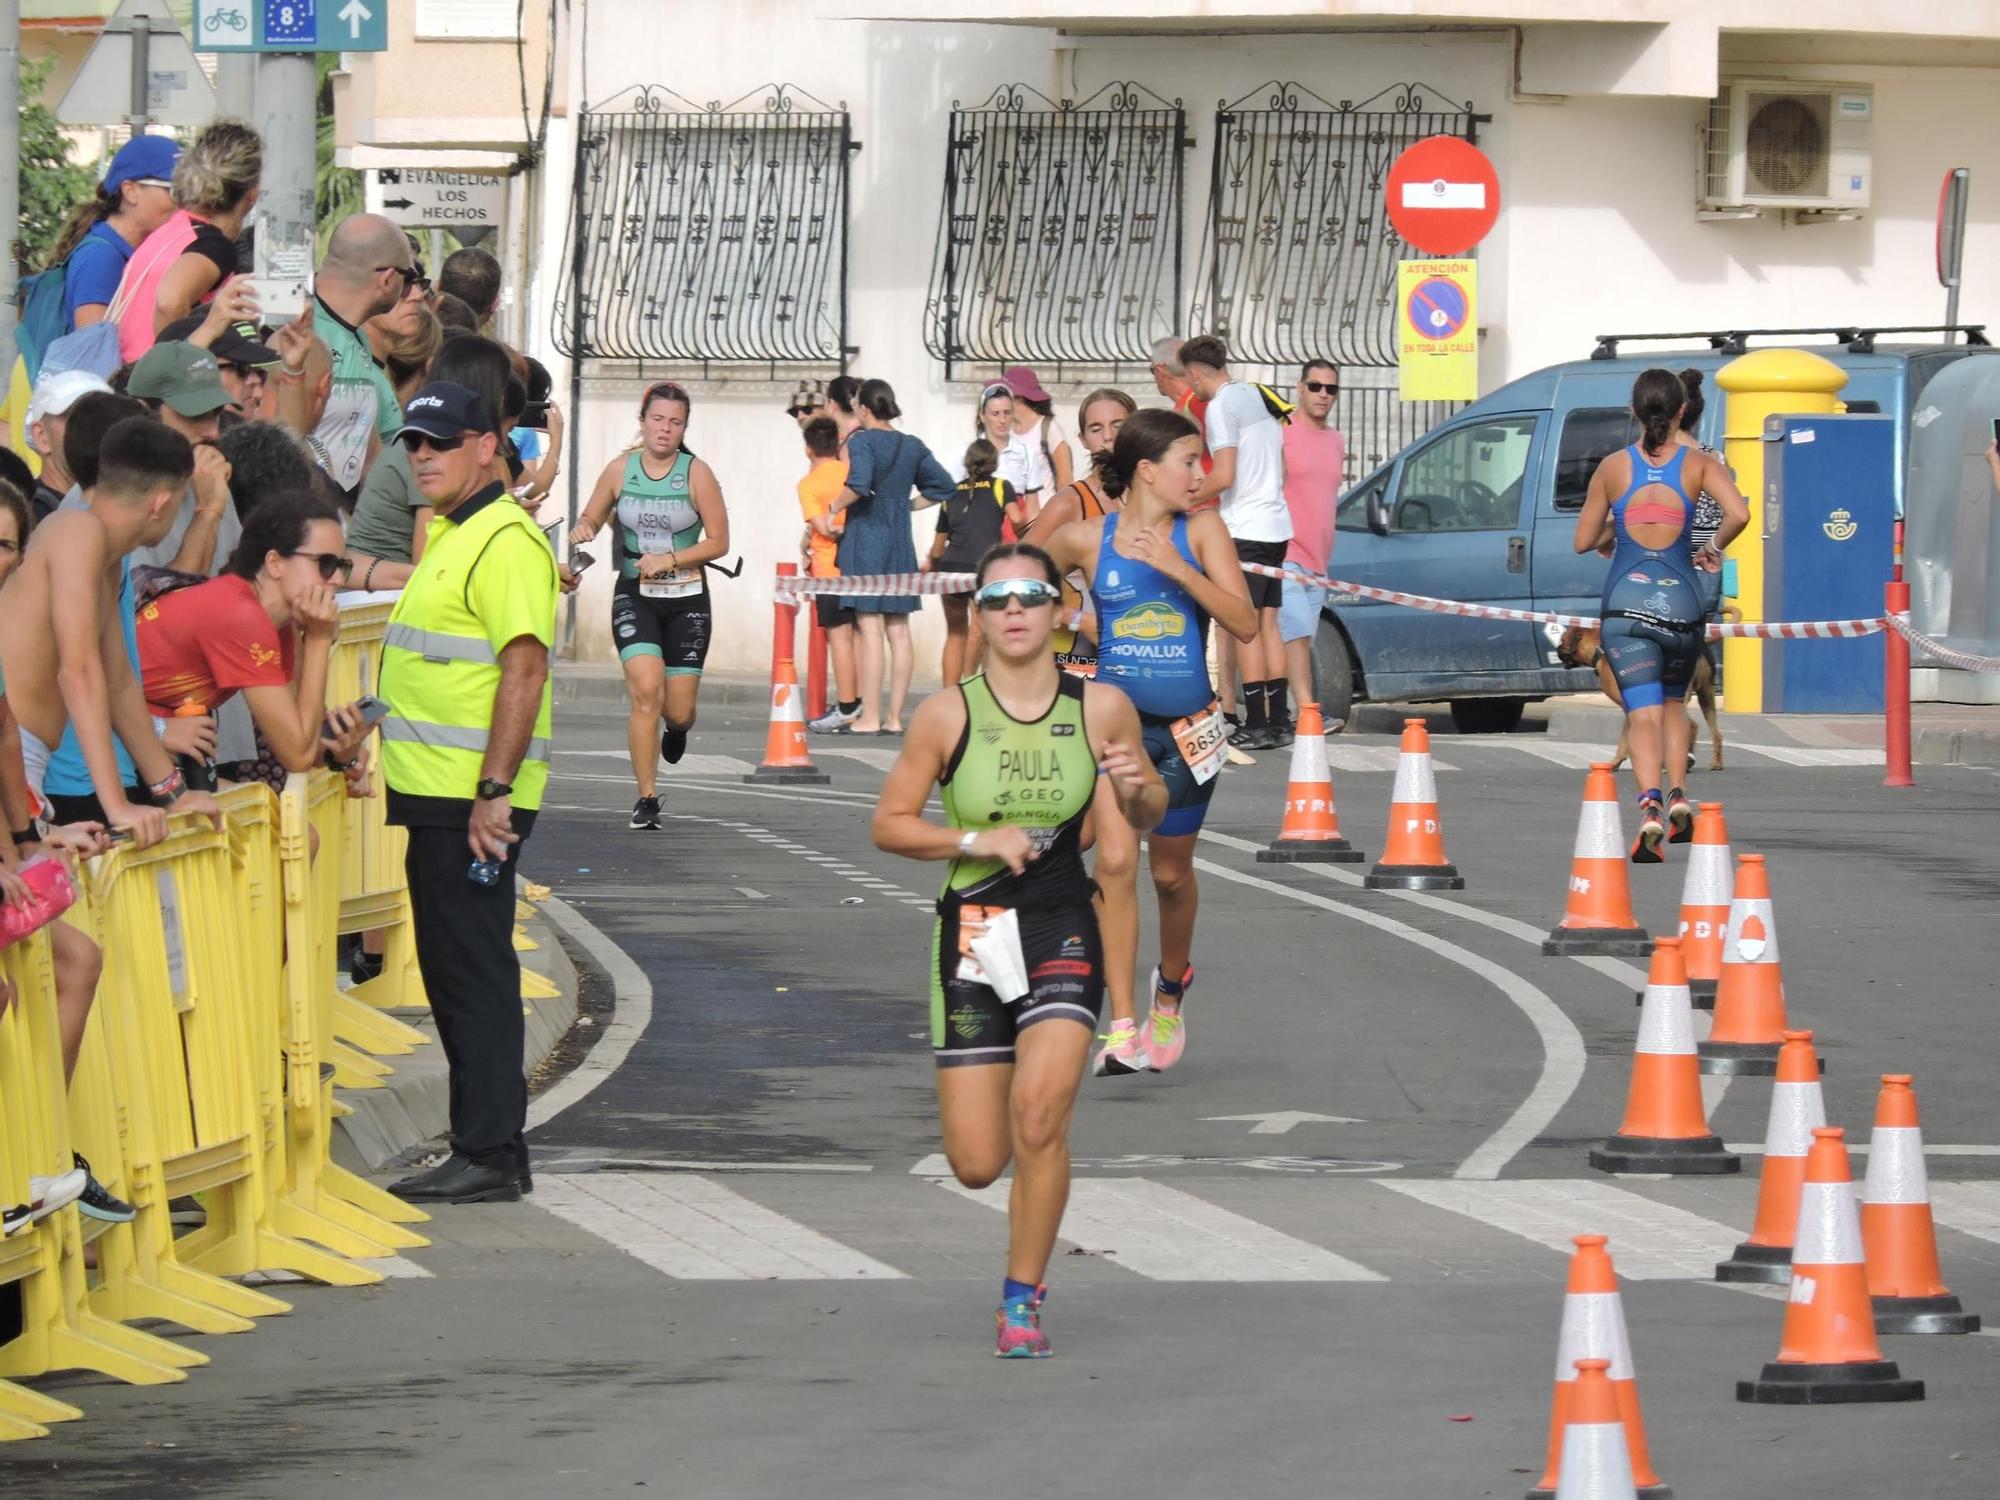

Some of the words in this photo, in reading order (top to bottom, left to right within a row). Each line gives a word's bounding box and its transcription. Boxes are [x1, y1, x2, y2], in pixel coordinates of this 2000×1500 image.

[280, 6, 294, 26] 8
[437, 190, 468, 202] LOS
[422, 207, 487, 219] HECHOS
[1406, 263, 1468, 273] ATENCIÓN
[1403, 344, 1414, 352] EN
[1416, 343, 1437, 352] TODA
[1439, 343, 1449, 352] LA
[1450, 342, 1475, 352] CALLE
[638, 512, 672, 530] ASENSI
[1110, 644, 1187, 657] NOVALUX
[1186, 723, 1222, 756] 2631
[998, 750, 1063, 782] PAULA
[1020, 788, 1064, 801] GEO
